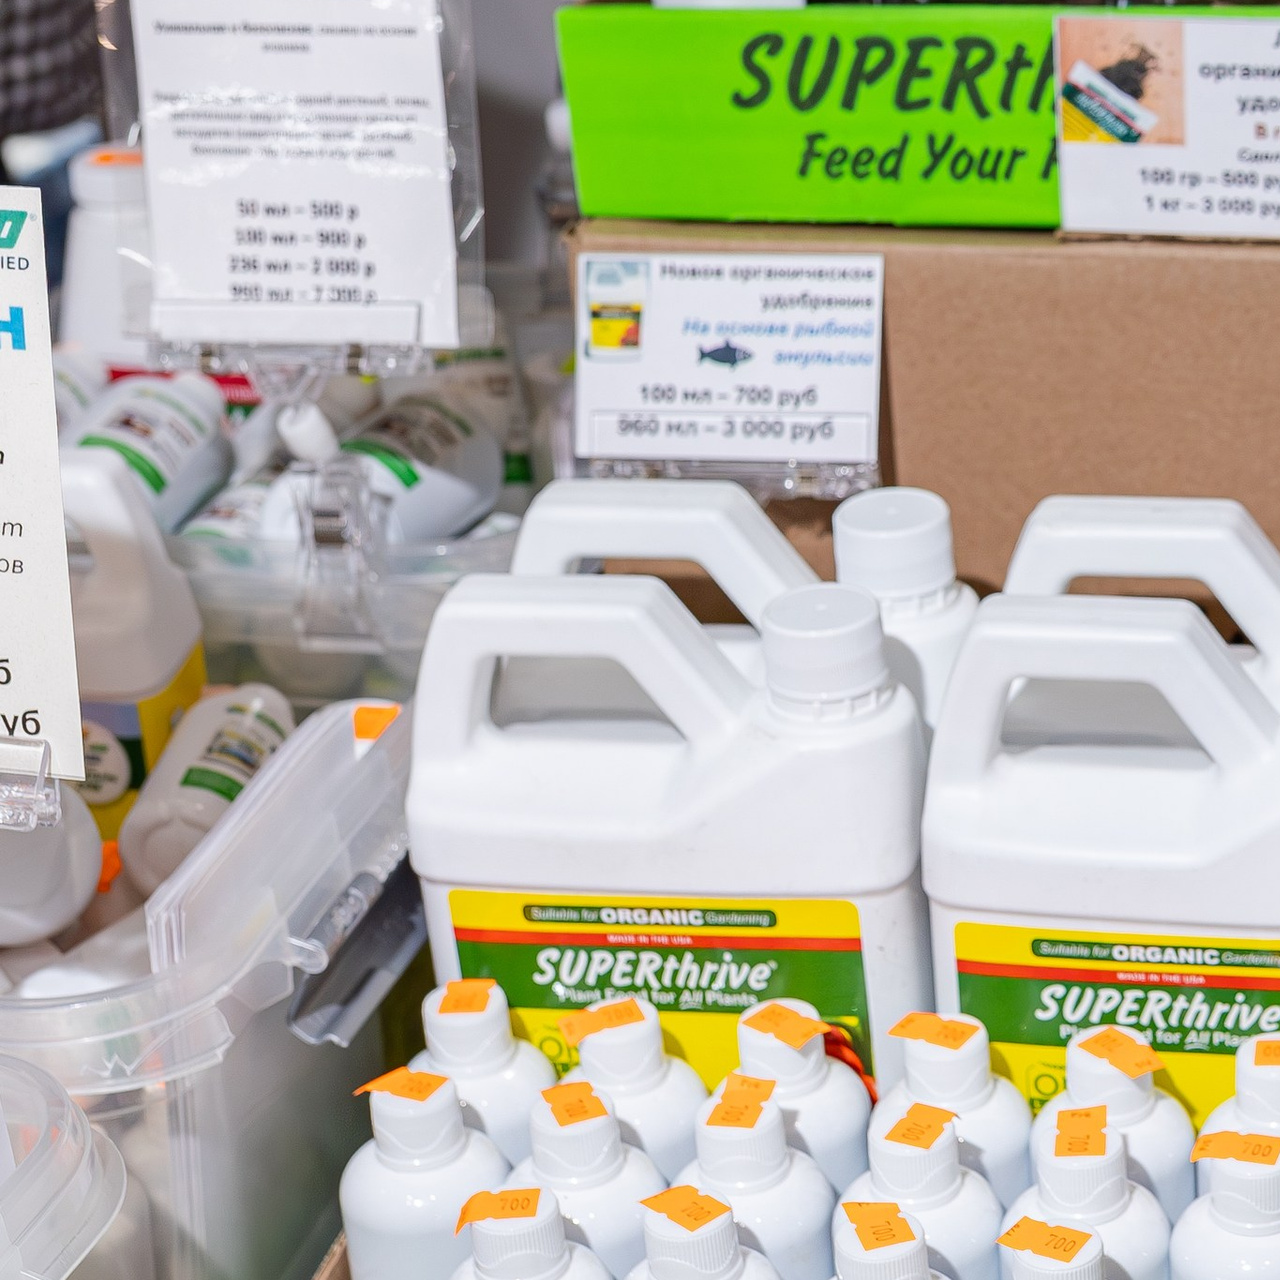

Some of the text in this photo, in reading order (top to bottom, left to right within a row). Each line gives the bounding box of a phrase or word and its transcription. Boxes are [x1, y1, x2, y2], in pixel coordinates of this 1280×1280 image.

[798, 132, 910, 182] Feed
[920, 132, 1027, 182] Your
[1140, 168, 1174, 185] 100
[640, 384, 676, 403] 100
[735, 386, 772, 404] 700
[777, 385, 818, 409] руб
[790, 417, 834, 442] руб
[600, 907, 704, 926] ORGANIC
[1112, 945, 1220, 965] ORGANIC
[532, 947, 772, 991] SUPERthrive
[651, 990, 676, 1004] for
[679, 990, 703, 1004] All
[706, 990, 758, 1006] Plants
[1156, 1030, 1209, 1045] for All
[1241, 1141, 1272, 1157] 700
[500, 1196, 531, 1212] 700
[681, 1200, 711, 1222] 700
[1043, 1233, 1077, 1253] 700
